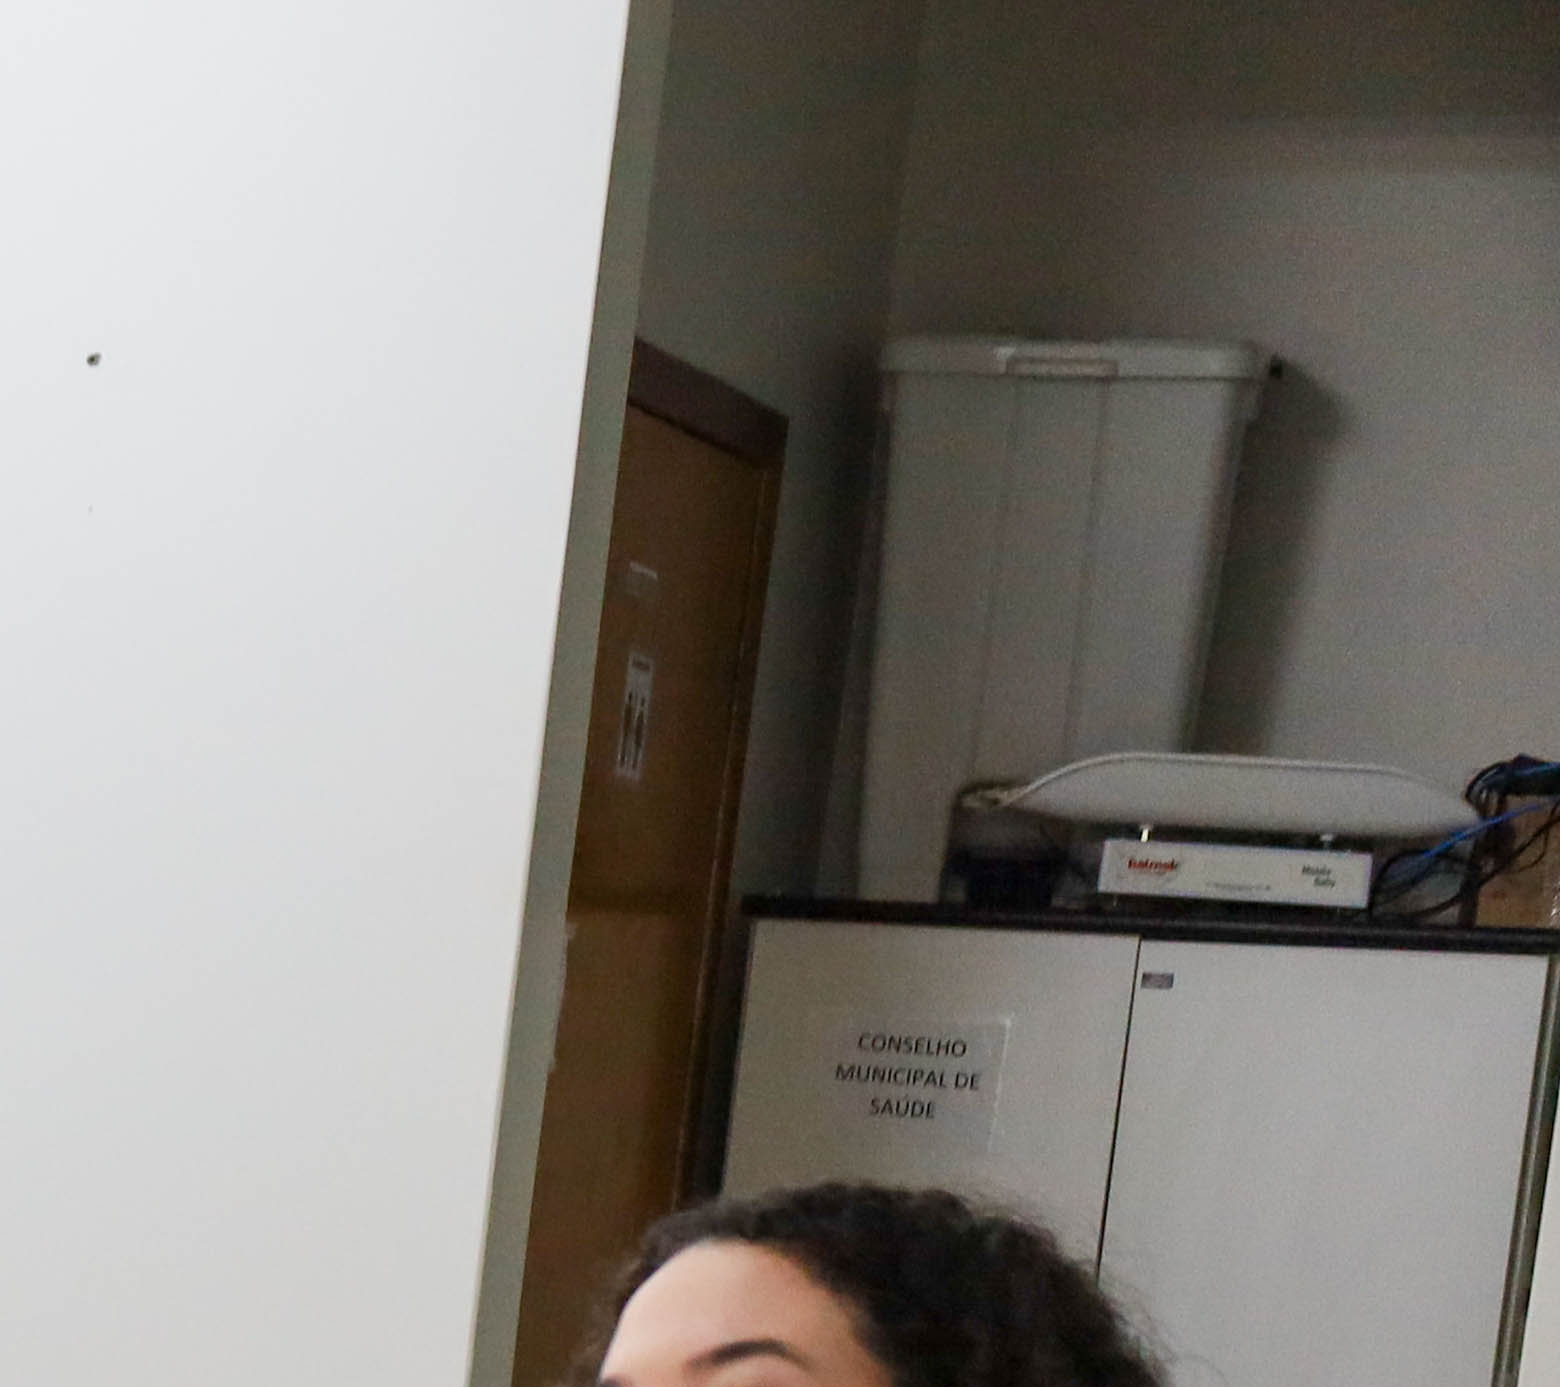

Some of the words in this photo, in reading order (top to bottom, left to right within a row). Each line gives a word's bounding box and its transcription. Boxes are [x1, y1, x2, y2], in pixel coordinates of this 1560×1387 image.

[857, 1031, 968, 1059] CONSELHO
[833, 1063, 948, 1090] MUNICIPAL
[953, 1072, 981, 1092] DE
[869, 1094, 937, 1120] SAÚDE
